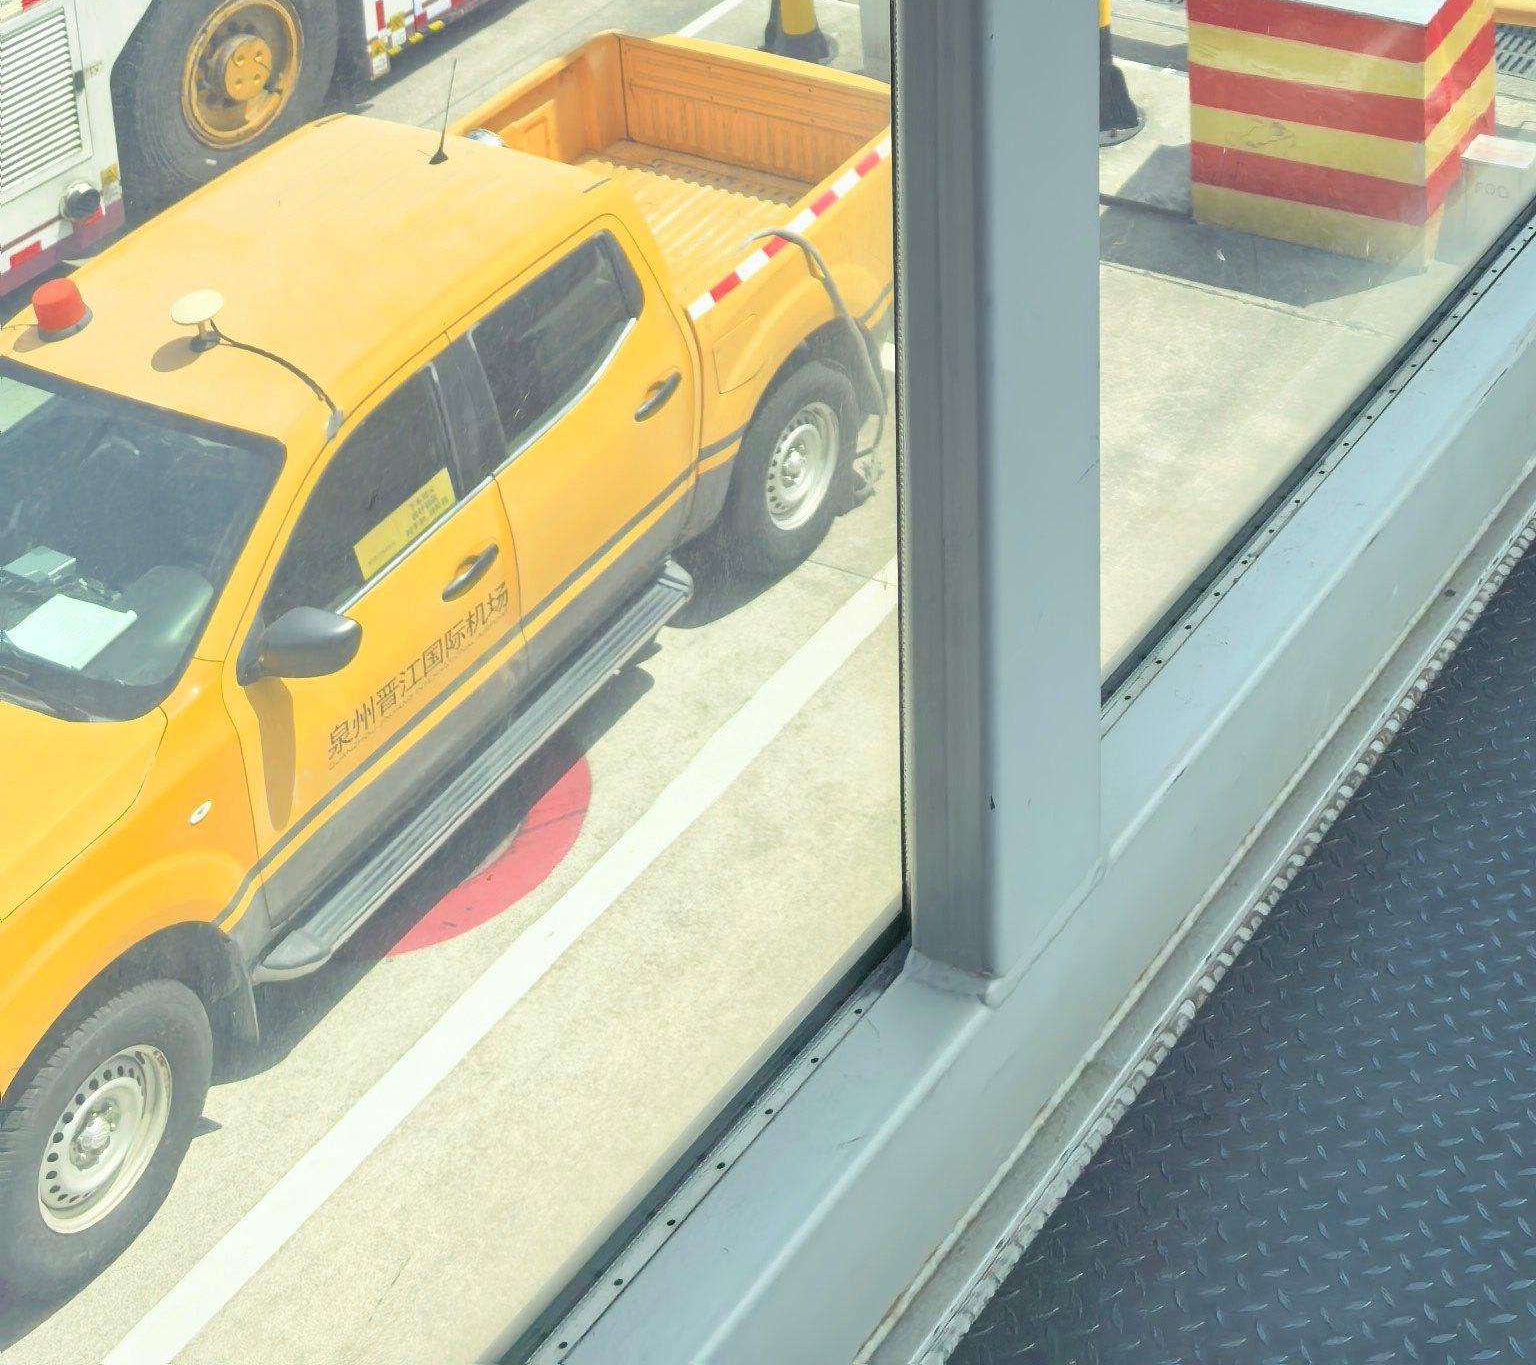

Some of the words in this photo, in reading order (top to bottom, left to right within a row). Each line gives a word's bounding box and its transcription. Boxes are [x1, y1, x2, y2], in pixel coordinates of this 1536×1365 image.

[328, 581, 509, 759] 泉州晋江国际机场
